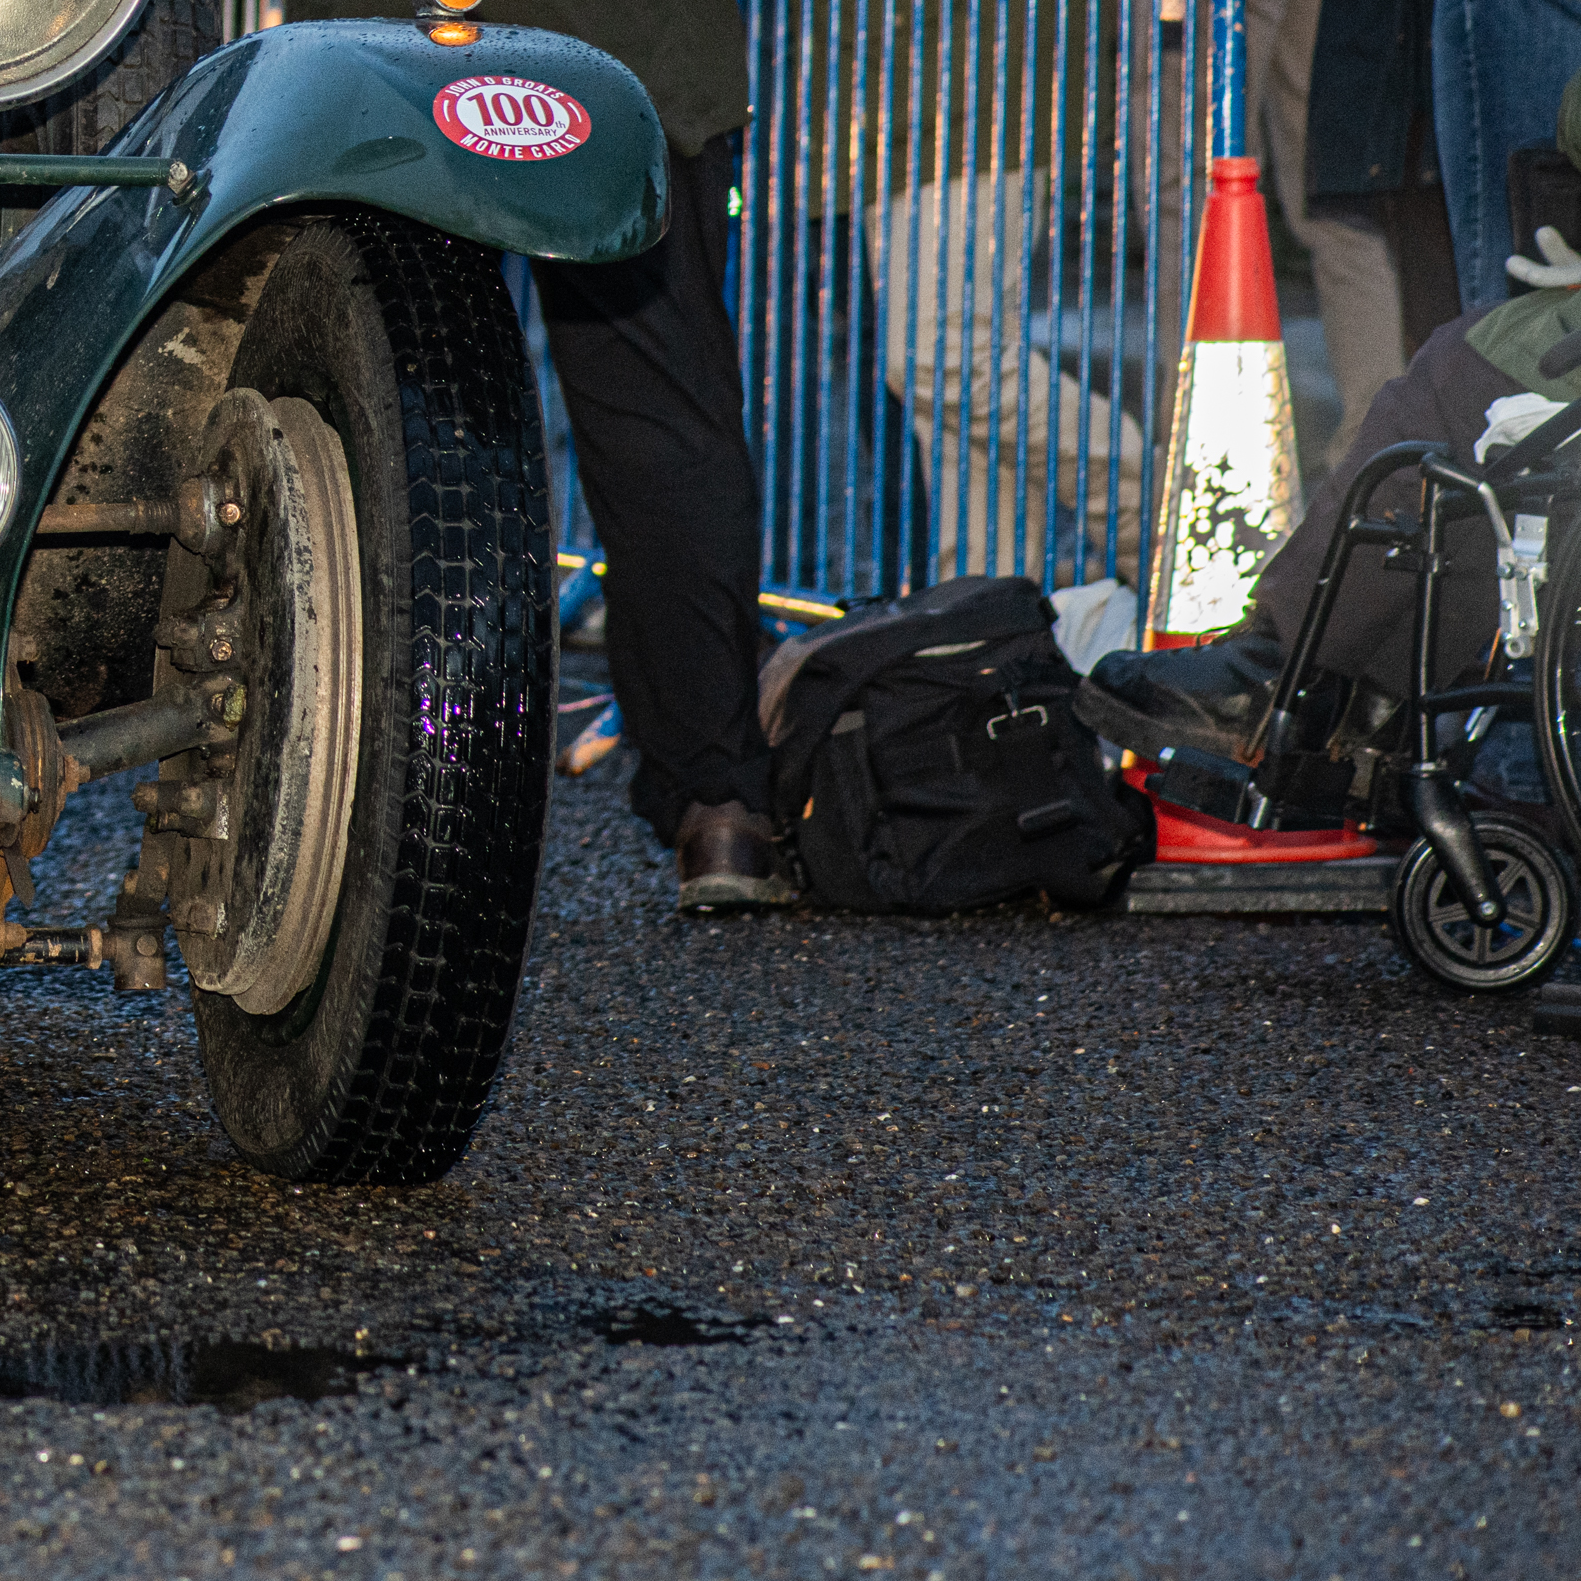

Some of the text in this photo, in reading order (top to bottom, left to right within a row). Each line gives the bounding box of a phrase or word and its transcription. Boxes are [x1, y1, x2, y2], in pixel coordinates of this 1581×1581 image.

[445, 78, 481, 97] JOHN
[501, 77, 565, 99] GROATS
[483, 127, 557, 137] ANNIVERSARY
[460, 133, 581, 159] MONTE CARLO
